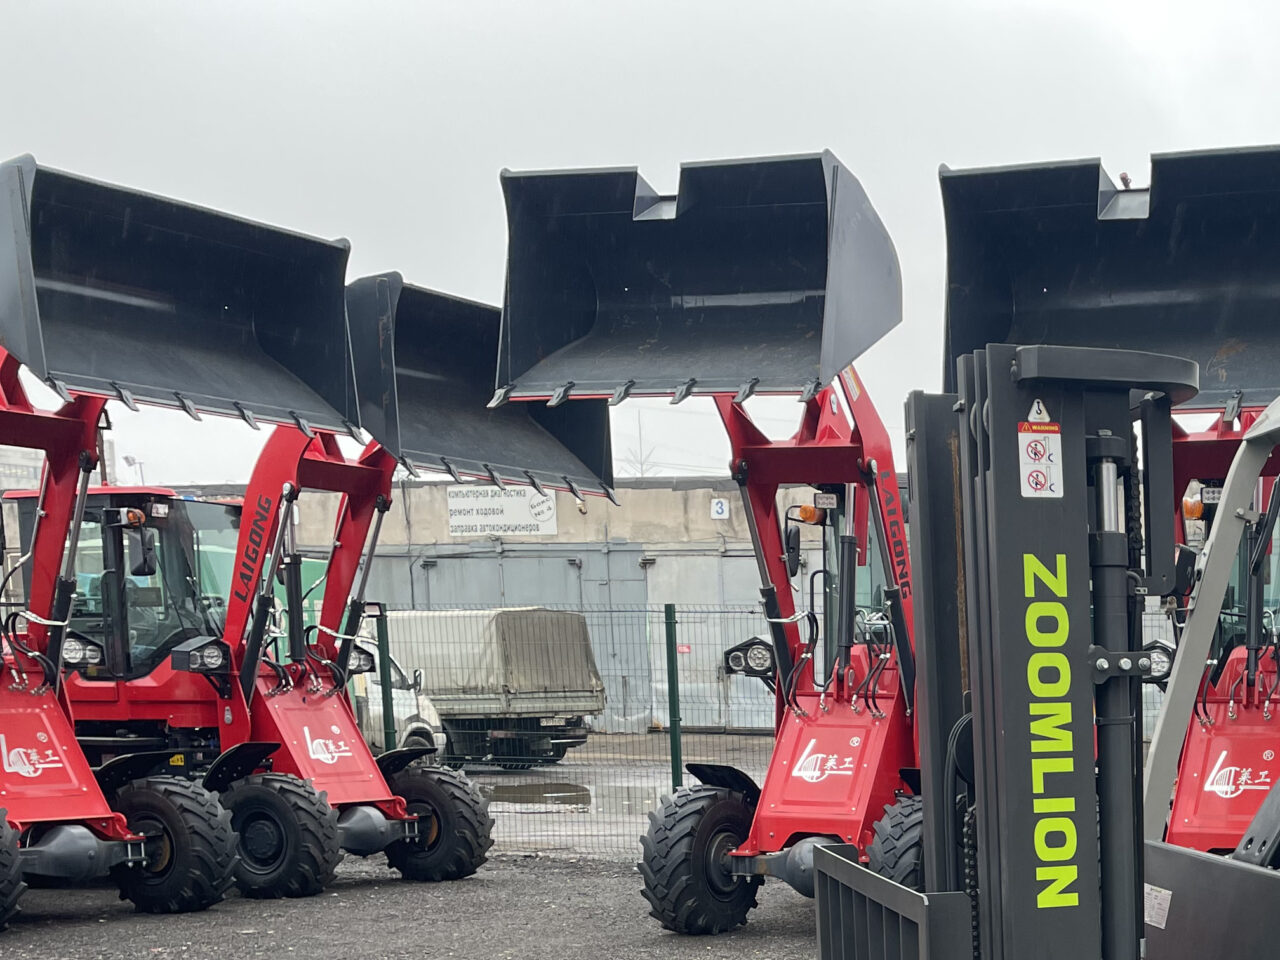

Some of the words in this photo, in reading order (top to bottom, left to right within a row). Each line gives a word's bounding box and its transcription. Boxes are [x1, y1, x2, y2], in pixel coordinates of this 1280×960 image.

[234, 494, 273, 603] LAIGONG
[449, 508, 473, 518] ремонт
[715, 500, 725, 515] 3
[880, 471, 912, 600] LAIGONG
[1023, 553, 1079, 909] ZOOMLION
